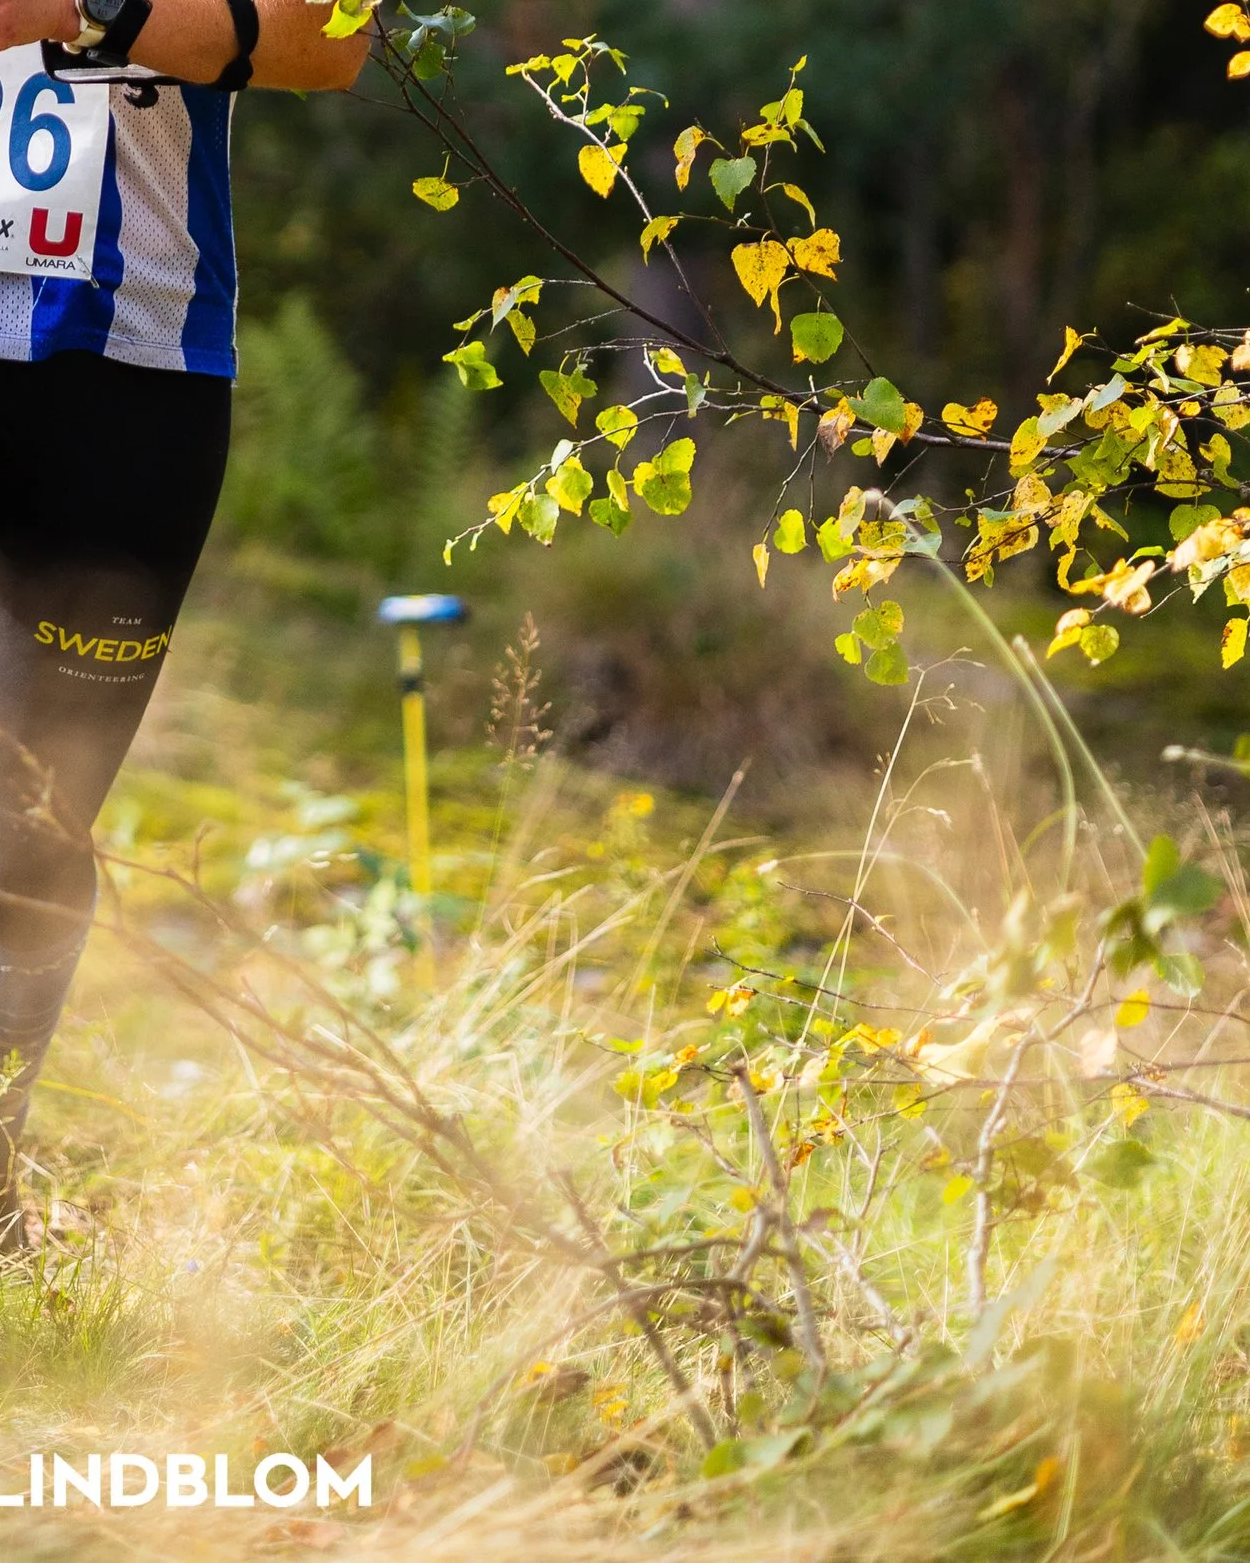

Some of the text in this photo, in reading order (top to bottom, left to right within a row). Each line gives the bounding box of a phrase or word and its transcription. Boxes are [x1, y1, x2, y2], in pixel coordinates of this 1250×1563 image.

[28, 207, 84, 258] U
[25, 256, 76, 270] UMARA
[111, 616, 143, 626] TEAM
[34, 620, 173, 662] SWEDEN
[58, 665, 147, 683] ORIENTEERING
